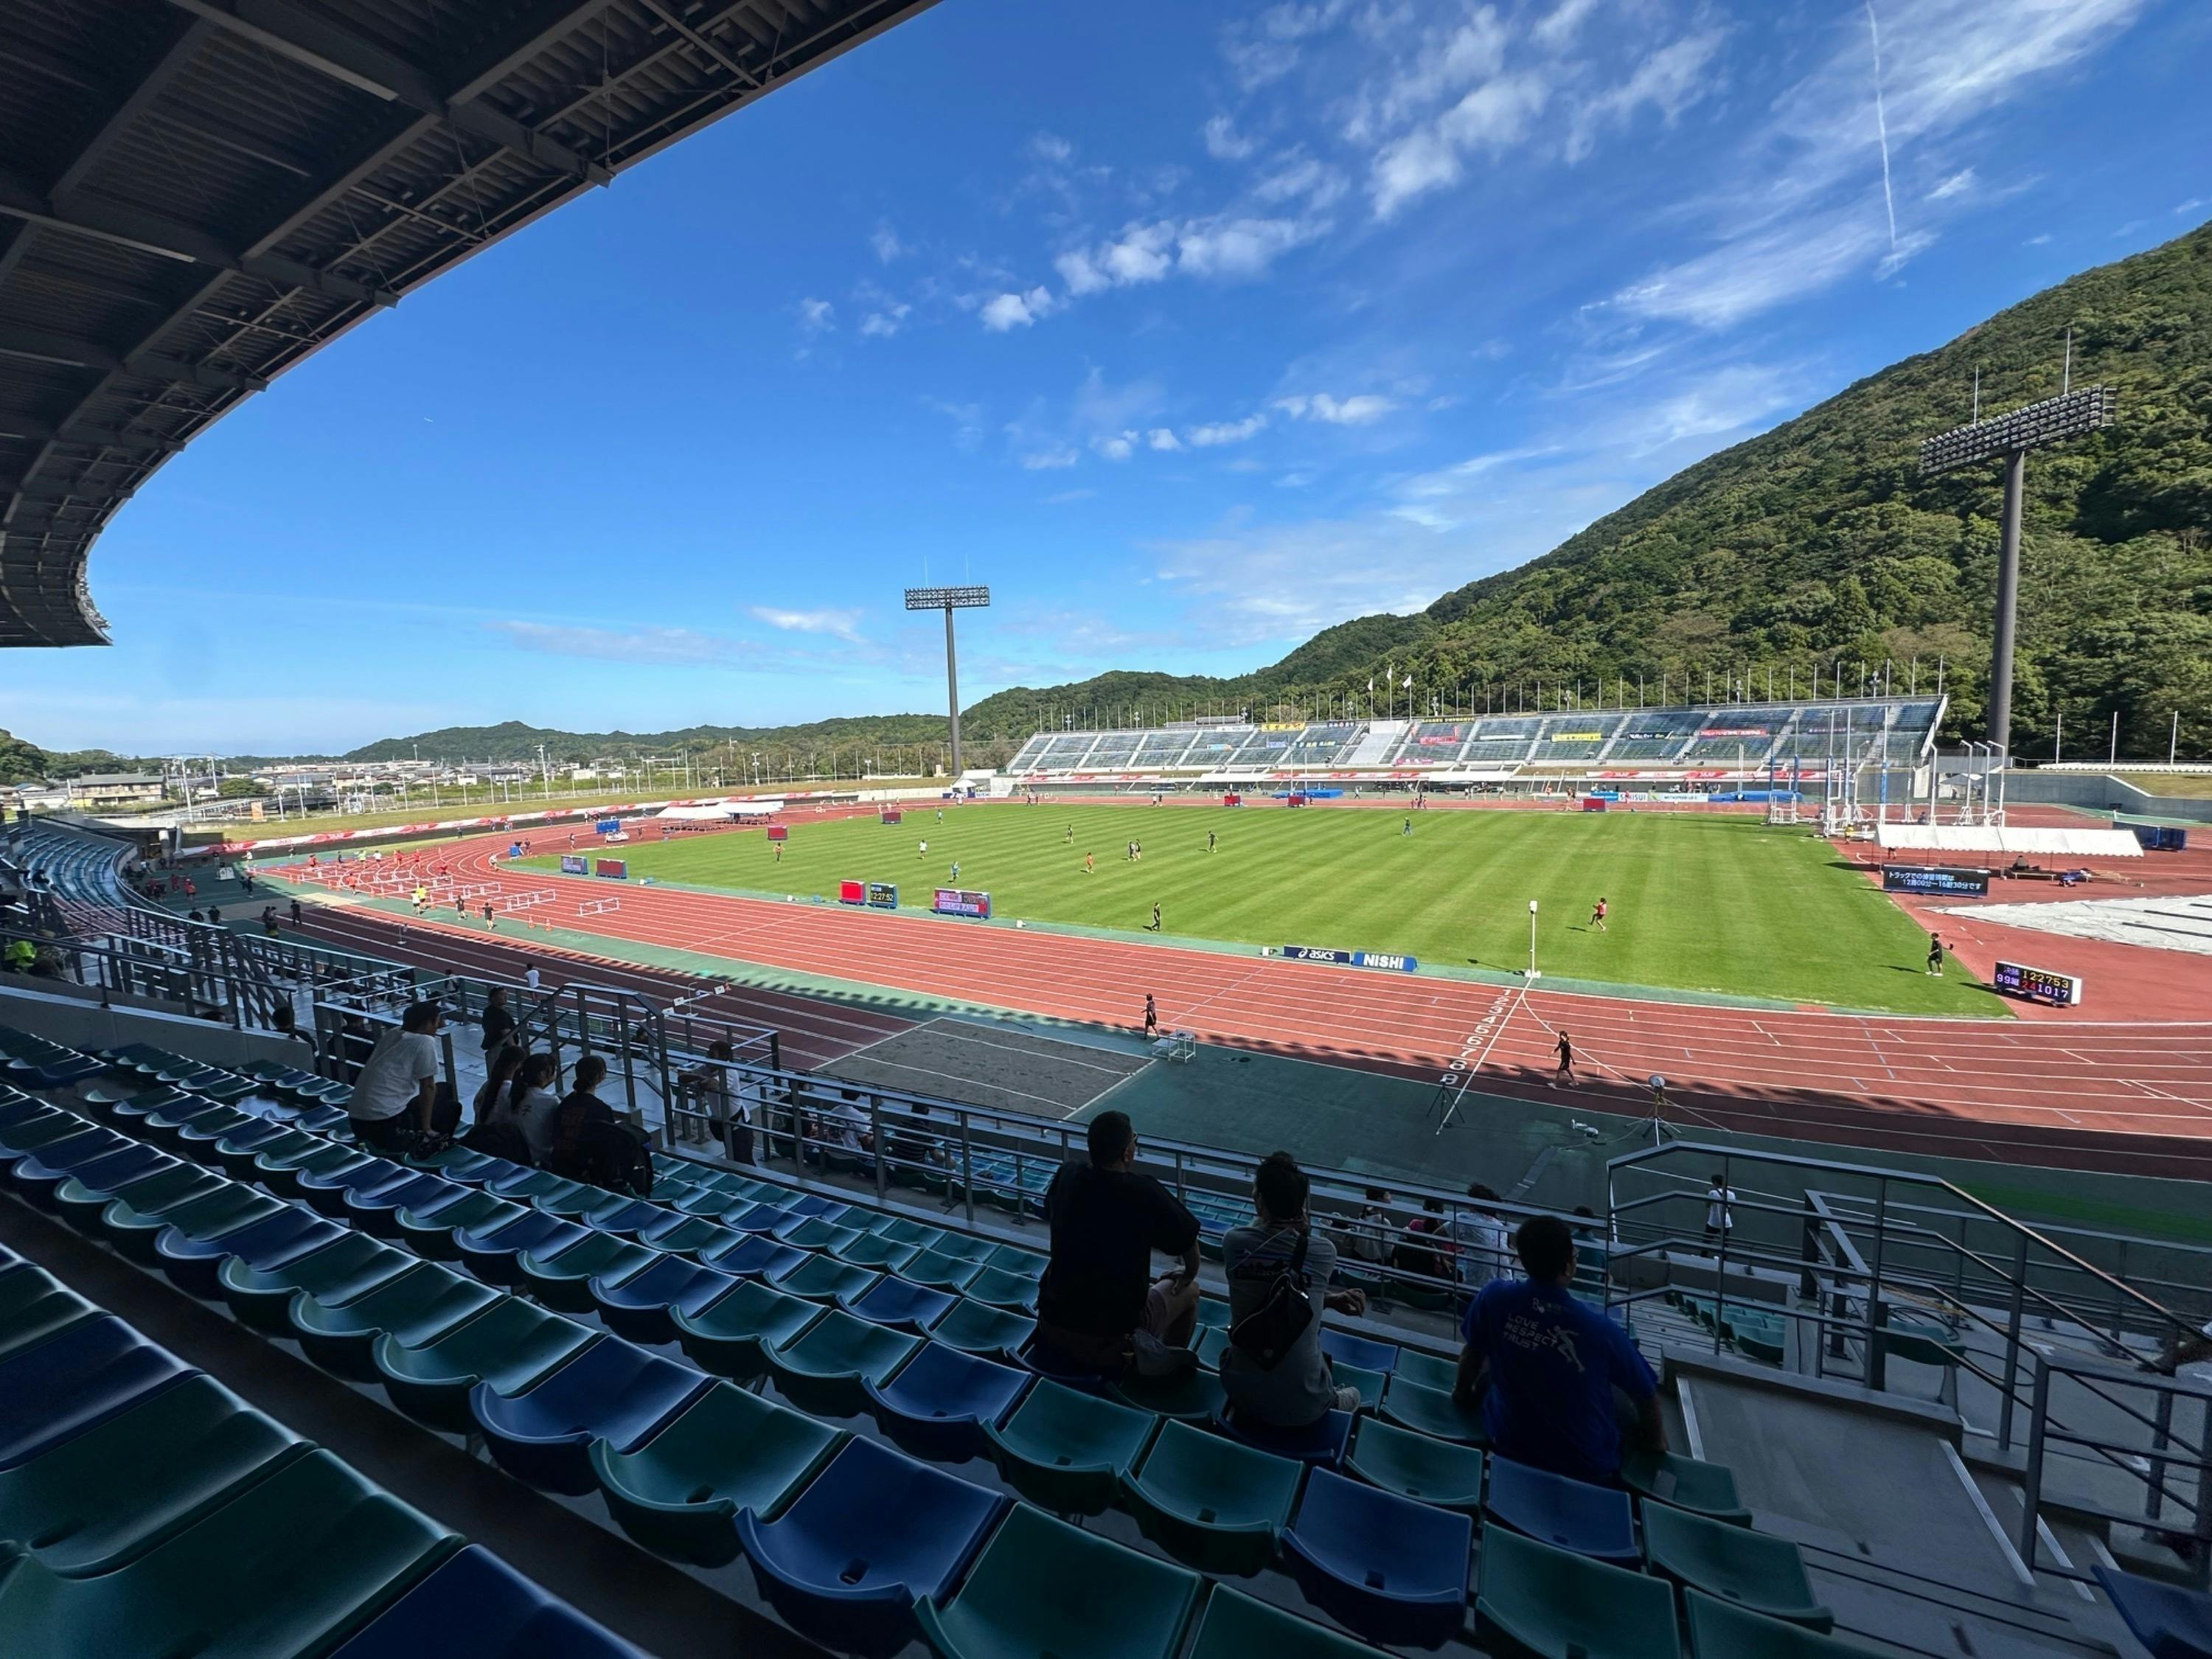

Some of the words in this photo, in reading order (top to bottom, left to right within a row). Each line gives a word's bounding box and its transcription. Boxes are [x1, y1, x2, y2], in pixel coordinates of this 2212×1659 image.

[1309, 950, 1335, 960] asics
[1363, 954, 1404, 970] NISHI
[1495, 996, 1509, 1004] 2
[1489, 1006, 1503, 1014] 3
[1481, 1016, 1496, 1024] 4
[1474, 1025, 1491, 1034] 5
[1467, 1036, 1484, 1046] 6
[1461, 1047, 1477, 1057] 7
[1449, 1060, 1467, 1071] 8
[1508, 1312, 1539, 1330] LOVE
[1505, 1322, 1557, 1348] RESPECT
[1503, 1332, 1540, 1350] TRUST
